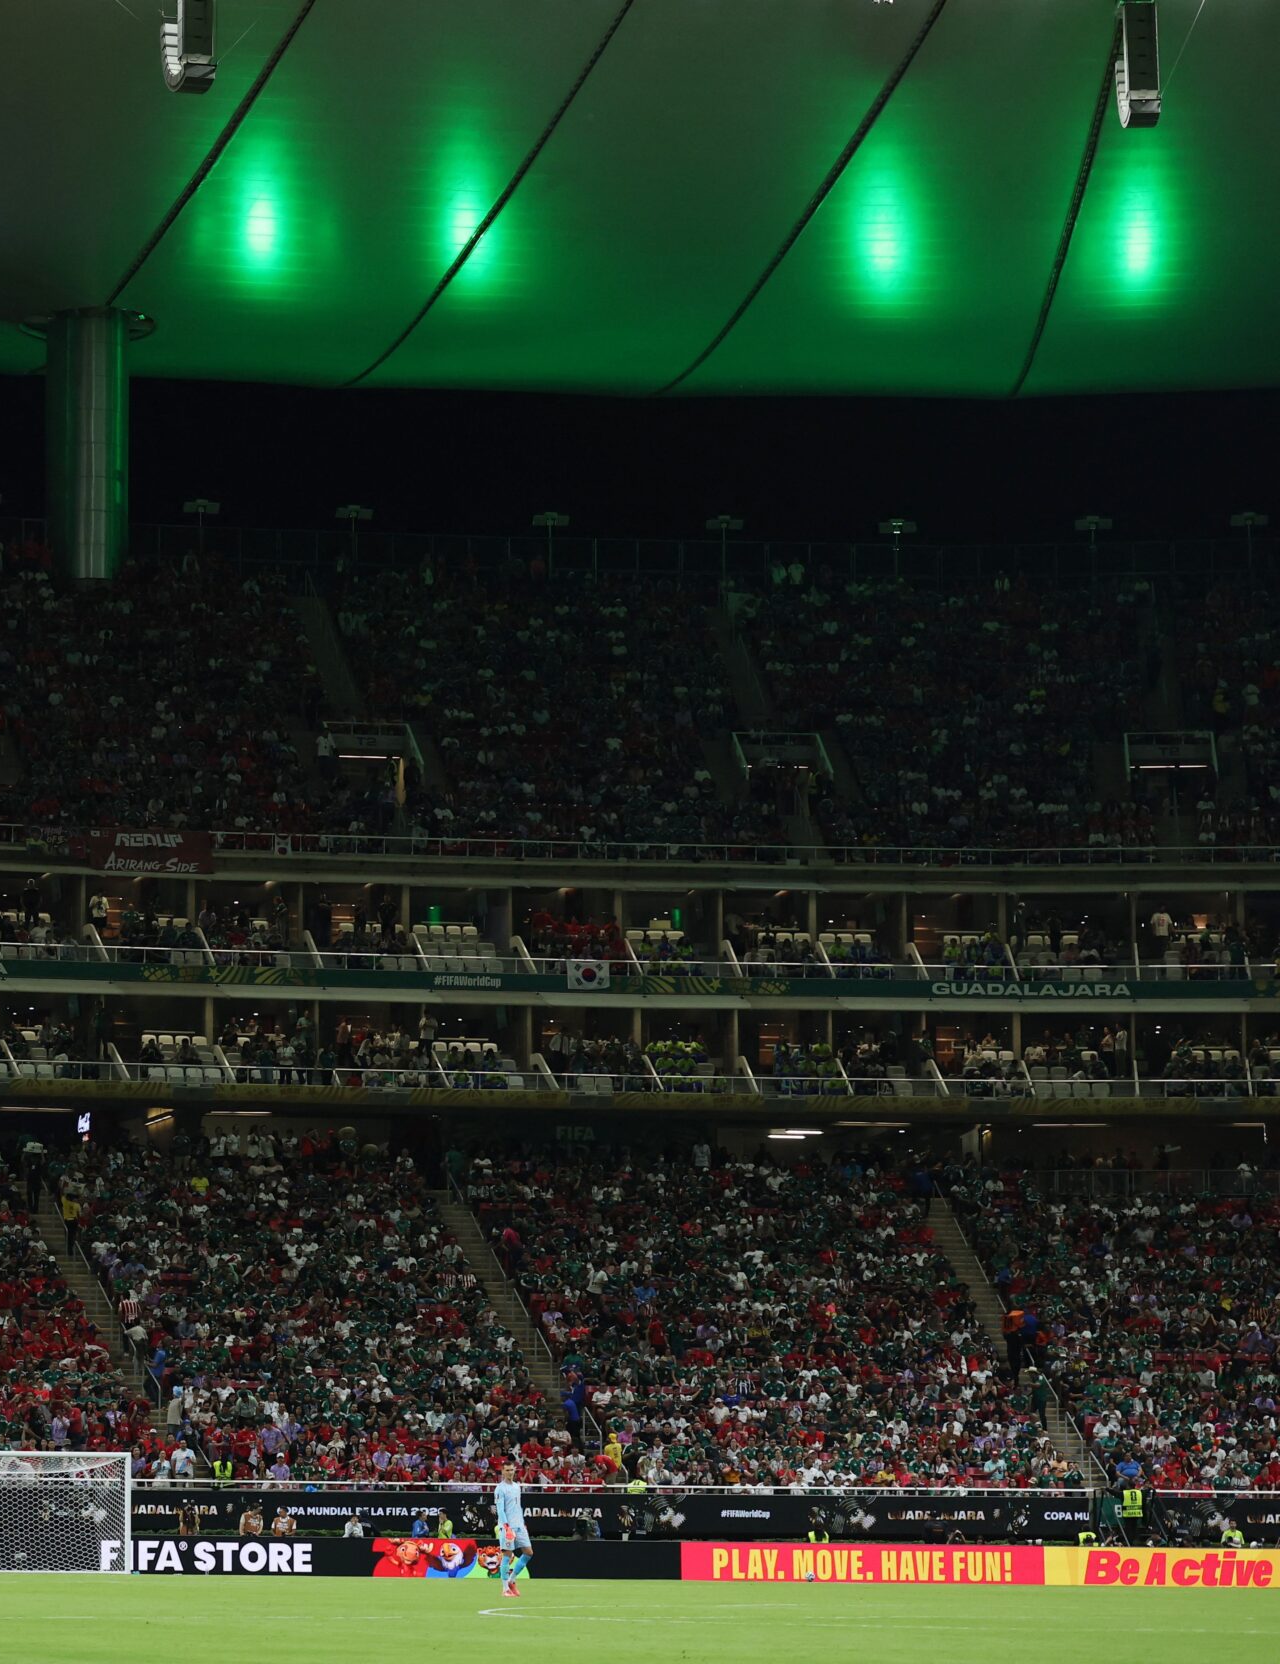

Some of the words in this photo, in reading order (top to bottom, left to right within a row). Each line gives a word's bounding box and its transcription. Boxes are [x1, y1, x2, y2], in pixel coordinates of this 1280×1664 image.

[356, 736, 377, 746] T2
[104, 851, 161, 871] ARIRANG
[165, 857, 200, 873] SIDE
[433, 975, 502, 989] #FIFAWorldCup
[931, 982, 1132, 997] GUADALAJARA
[556, 1125, 596, 1141] FIFA
[307, 1506, 353, 1517] MUNDIAL
[370, 1507, 384, 1517] LA
[386, 1507, 407, 1518] FIFA
[721, 1509, 770, 1519] #FIFAWorldCup
[1044, 1511, 1071, 1521] COPA
[193, 1541, 313, 1573] STORE
[712, 1548, 785, 1580] PLAY.
[792, 1549, 873, 1581] MOVE.
[881, 1550, 946, 1582] HAVE
[953, 1551, 1012, 1582] FUN!
[1084, 1550, 1140, 1585] Be
[1144, 1551, 1273, 1587] Active
